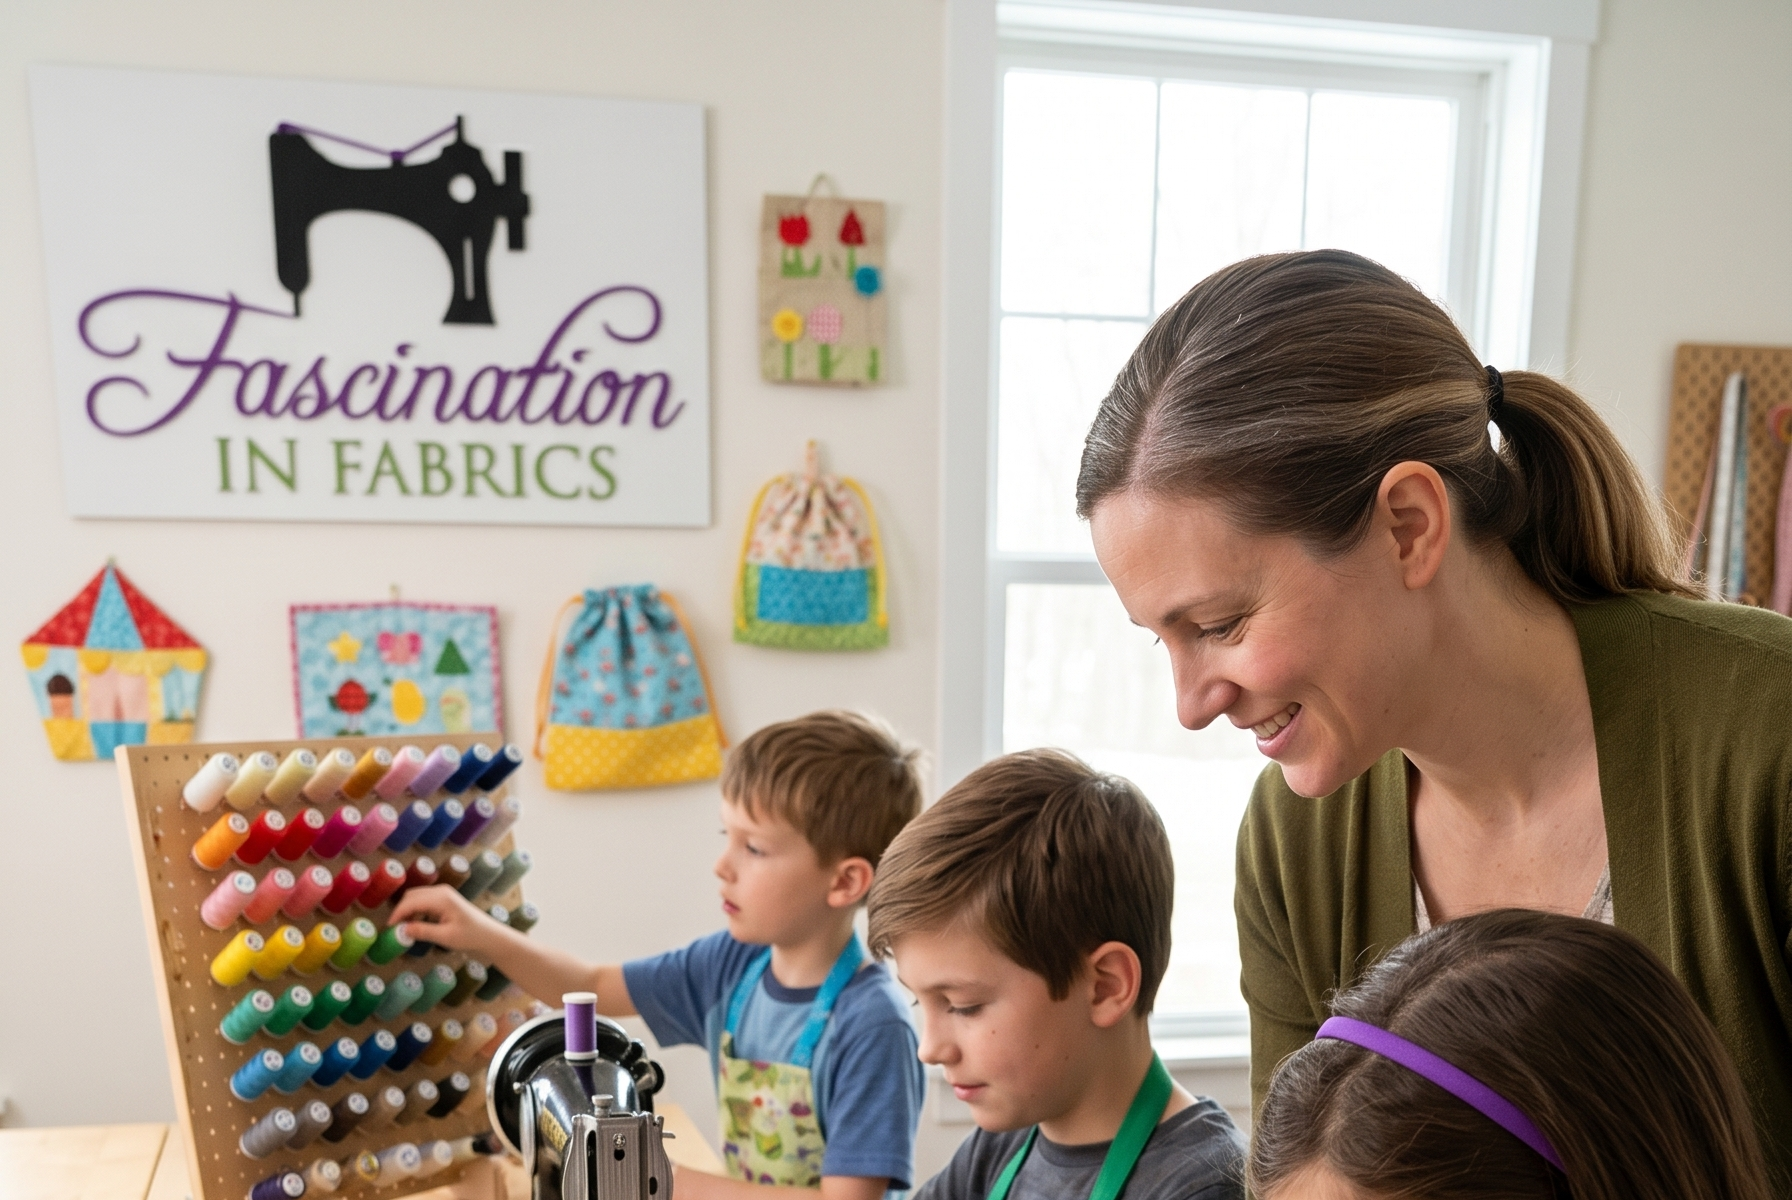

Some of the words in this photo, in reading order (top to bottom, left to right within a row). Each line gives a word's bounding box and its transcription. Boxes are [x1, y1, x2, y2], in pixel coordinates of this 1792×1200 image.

[78, 285, 687, 438] Fascination
[214, 438, 298, 495] IN
[331, 439, 619, 501] FABRICS
